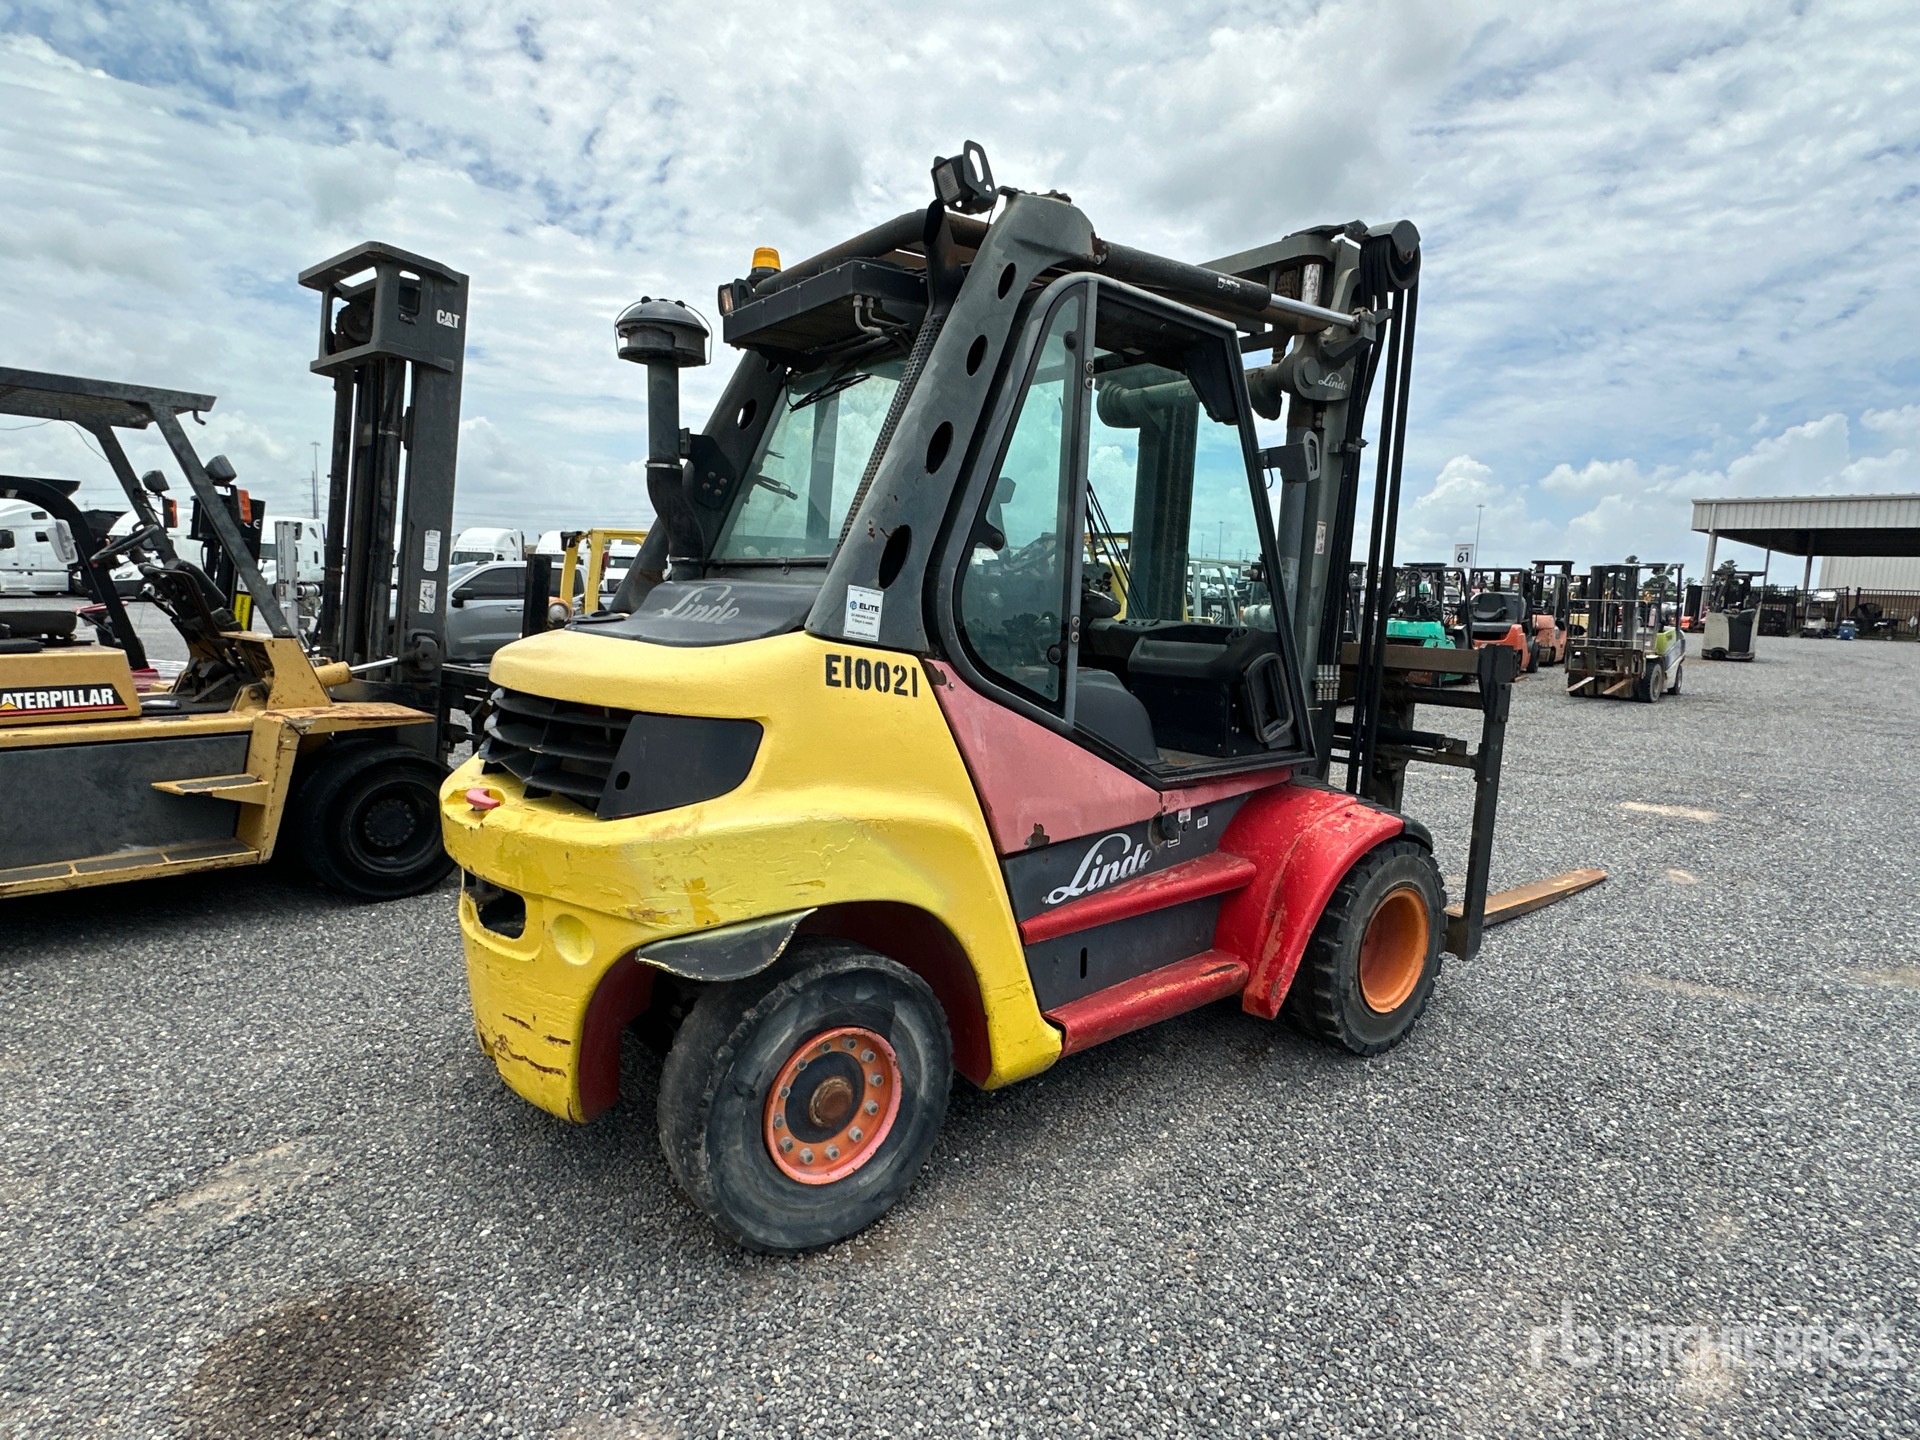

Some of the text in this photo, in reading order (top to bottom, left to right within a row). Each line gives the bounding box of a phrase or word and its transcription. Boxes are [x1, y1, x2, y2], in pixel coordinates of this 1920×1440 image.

[436, 309, 460, 329] CAT
[1317, 371, 1349, 391] Linde
[1456, 551, 1469, 563] 61
[655, 584, 740, 625] Linde
[859, 602, 879, 612] ELITE
[825, 653, 918, 698] E10021
[0, 688, 115, 710] ATERPILLAR
[1043, 832, 1153, 905] Linde
